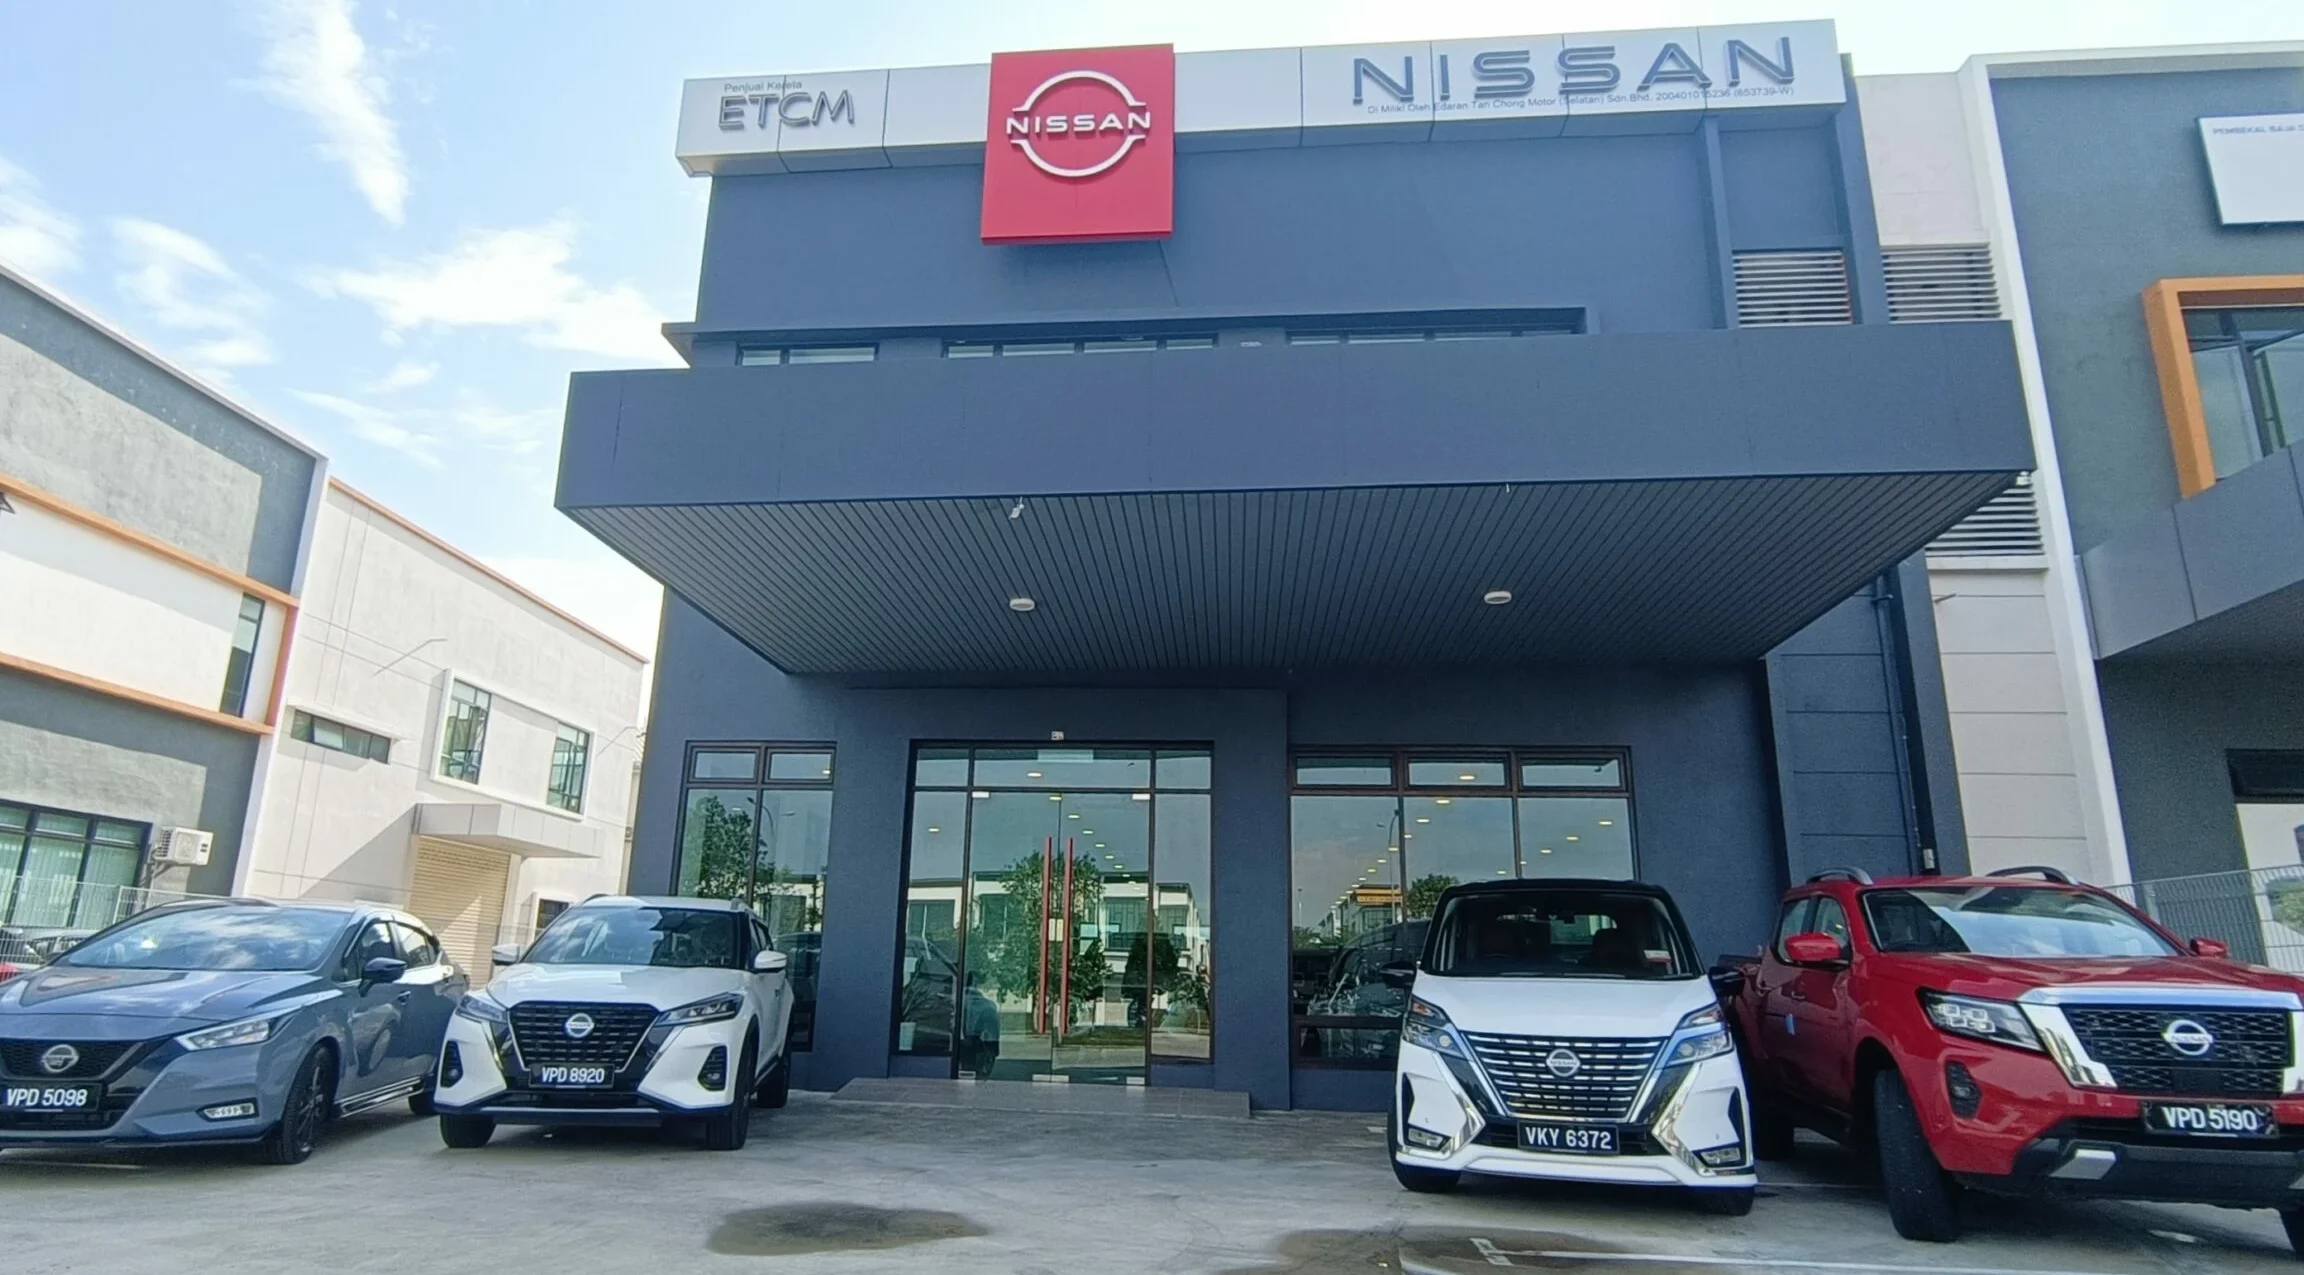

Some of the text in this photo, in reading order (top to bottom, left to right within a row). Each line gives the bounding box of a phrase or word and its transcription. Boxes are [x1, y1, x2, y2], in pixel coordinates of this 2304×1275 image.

[1353, 37, 1795, 105] NISSAN
[724, 82, 764, 93] Penjual
[719, 89, 855, 130] ETCM
[1408, 102, 1431, 112] Oleh
[1472, 100, 1490, 109] Tan
[1493, 98, 1525, 109] Chong
[1528, 97, 1556, 107] Motor
[1006, 111, 1150, 134] NISSAN
[542, 1067, 605, 1083] VPD 8920
[7, 1088, 88, 1106] VPD 5098
[2161, 1106, 2258, 1131] VPD 5190
[1525, 1126, 1612, 1150] VKY 6372
